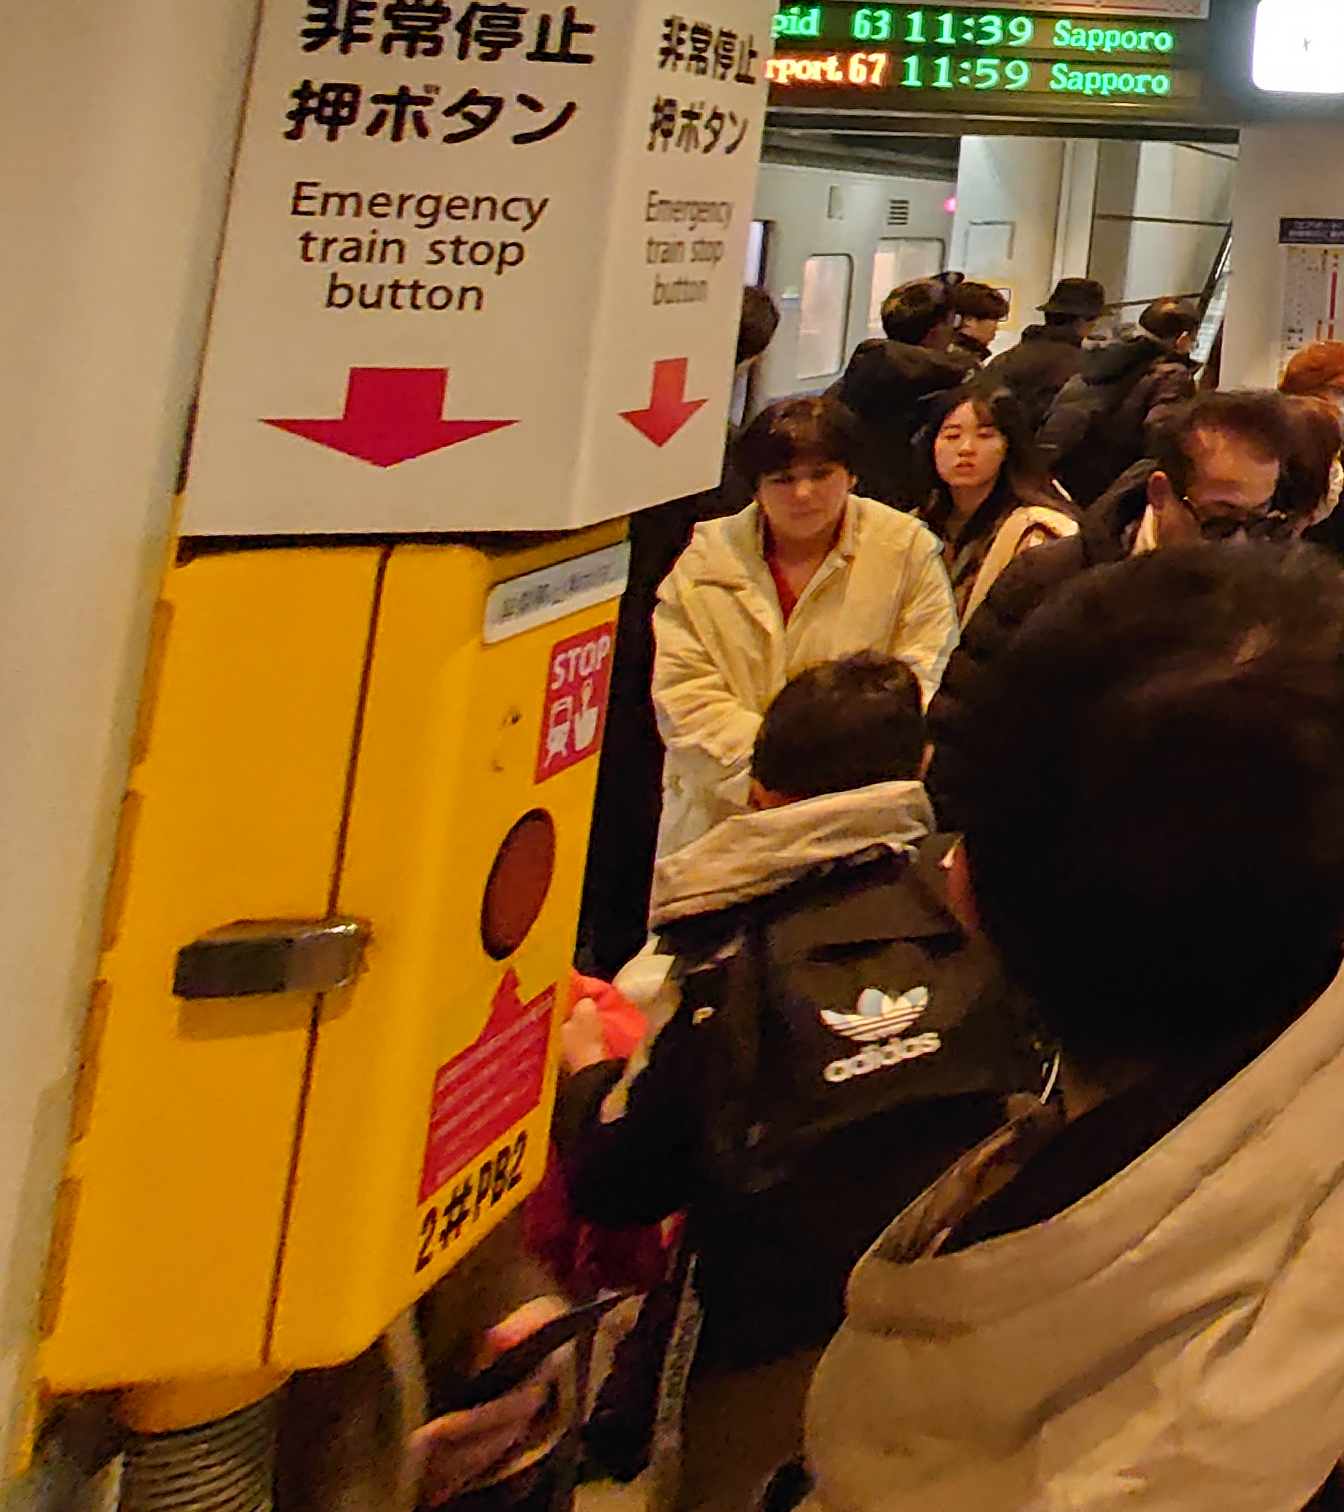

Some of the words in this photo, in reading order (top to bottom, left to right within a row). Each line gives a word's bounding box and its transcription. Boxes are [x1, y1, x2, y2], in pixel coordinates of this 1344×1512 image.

[657, 14, 758, 84] 非常停止
[853, 8, 892, 40] 63
[903, 10, 1035, 47] 11:39
[1053, 19, 1174, 53] Sapporo
[849, 51, 887, 88] 67
[901, 54, 1031, 91] 11:59
[1050, 62, 1171, 96] Sapporo
[283, 79, 577, 145] 押ボタン
[646, 94, 749, 155] 押ボタン
[290, 180, 551, 233] Emergency
[644, 189, 734, 232] Emergency
[298, 228, 407, 264] train
[425, 234, 525, 276] stop
[645, 233, 686, 265] train
[690, 238, 725, 270] stop
[325, 270, 485, 312] button
[652, 272, 708, 306] button
[551, 635, 612, 691] STOP
[822, 1031, 942, 1084] adidas
